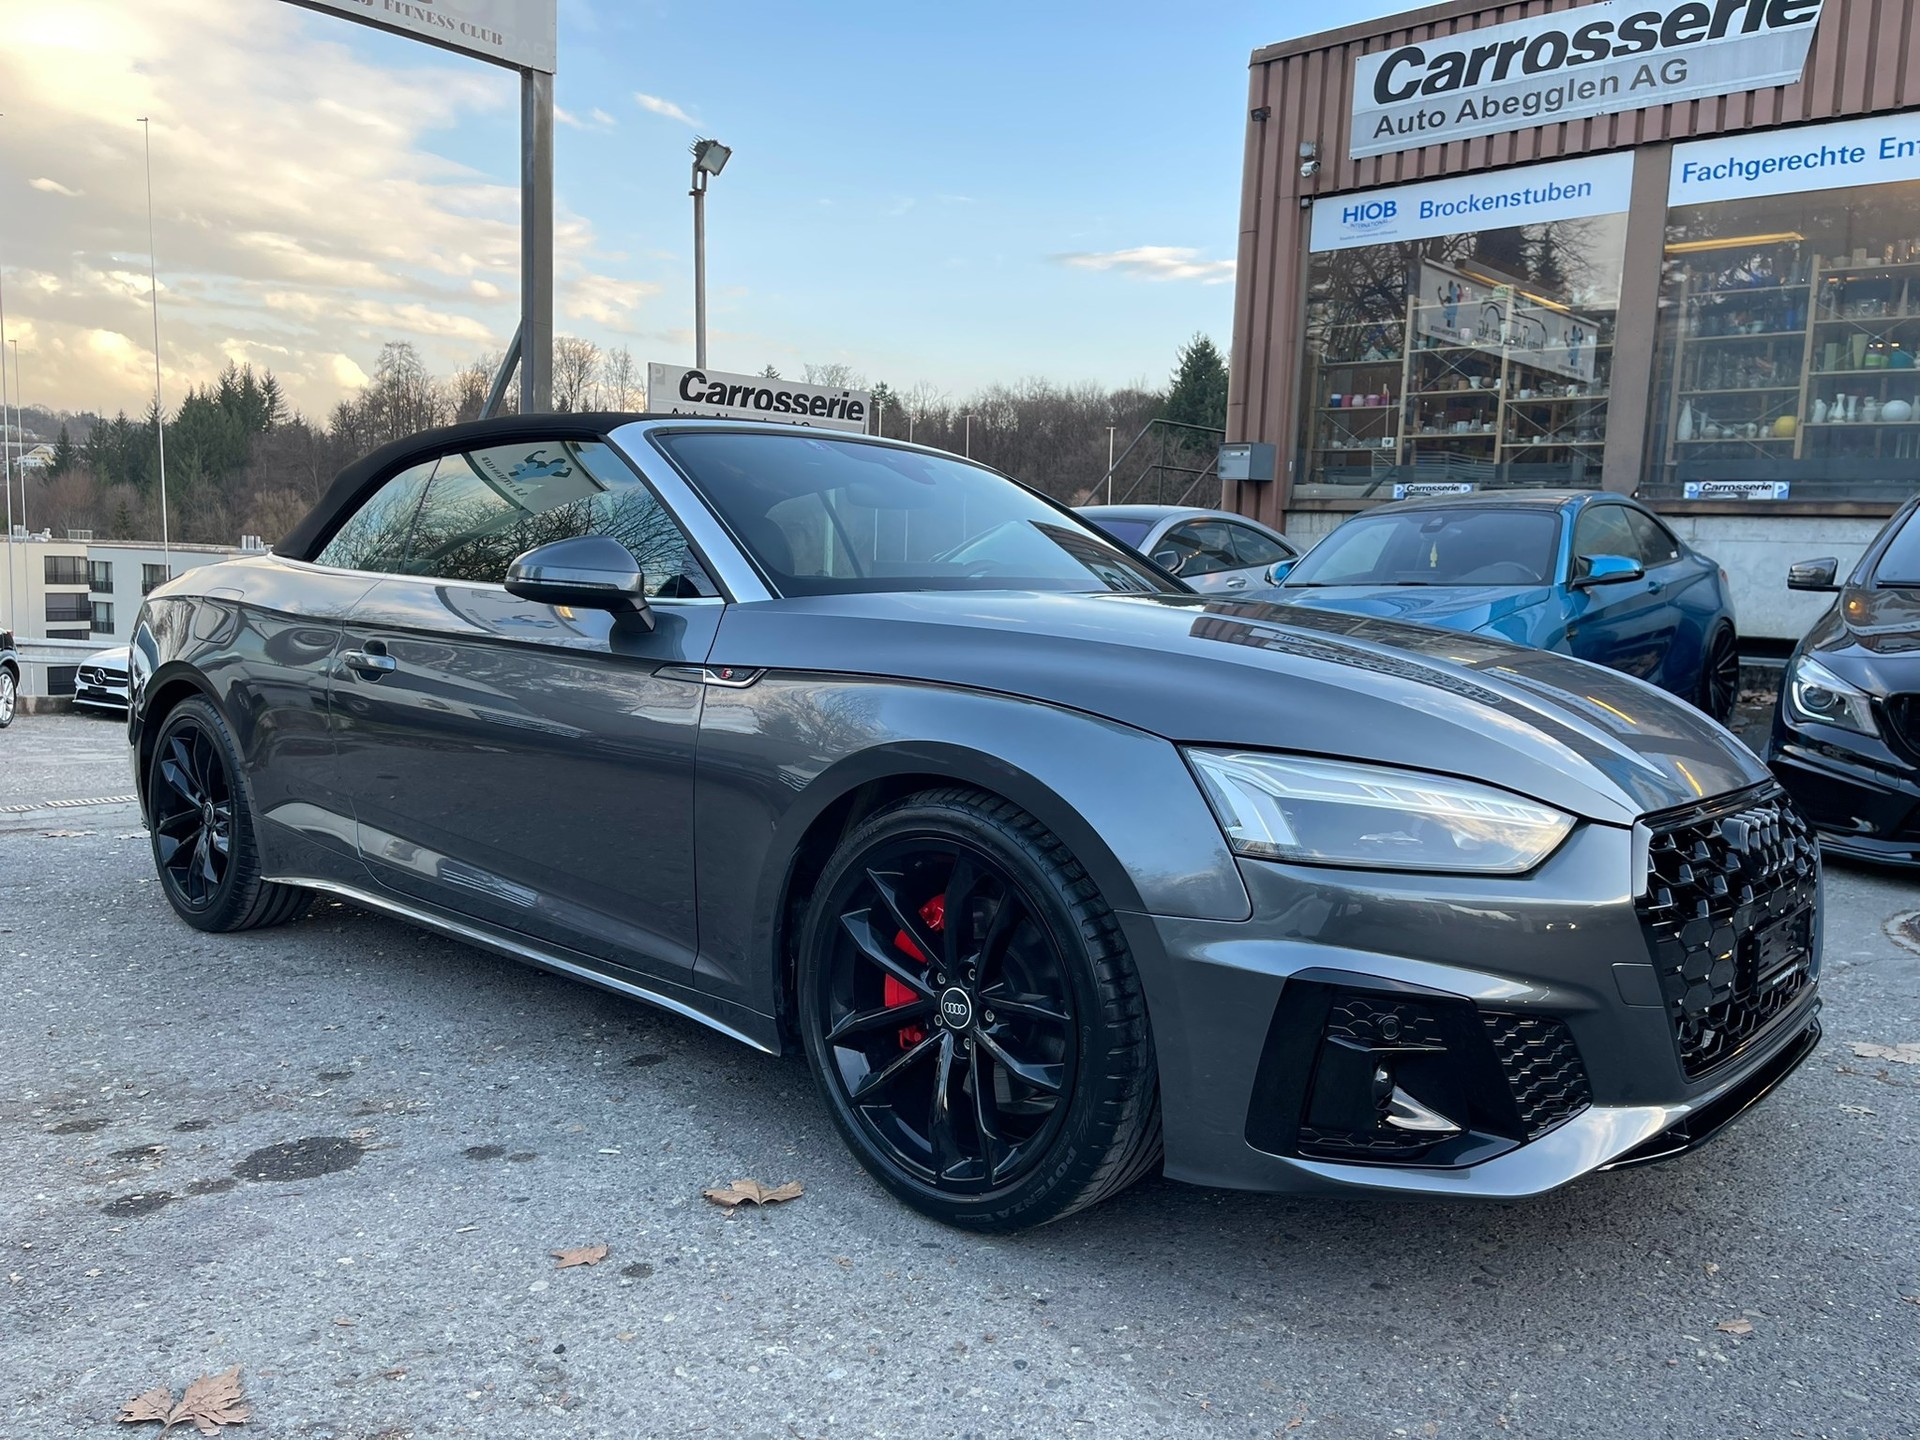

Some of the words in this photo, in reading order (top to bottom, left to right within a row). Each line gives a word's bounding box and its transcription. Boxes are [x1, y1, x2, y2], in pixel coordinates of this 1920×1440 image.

[384, 0, 455, 30] FITNESS
[460, 22, 503, 46] CLUB
[1374, 0, 1820, 104] Carrosserie
[1373, 108, 1447, 139] Auto
[1455, 75, 1619, 123] Abegglen
[1629, 58, 1688, 91] AG
[1682, 145, 1866, 183] Fachgerechte
[1343, 200, 1397, 224] HIOB
[1418, 180, 1592, 220] Brockenstuben
[678, 370, 865, 422] Carrosserie
[1702, 482, 1772, 491] Carrosserie
[1773, 482, 1788, 499] P
[996, 1146, 1078, 1219] POTENZA
